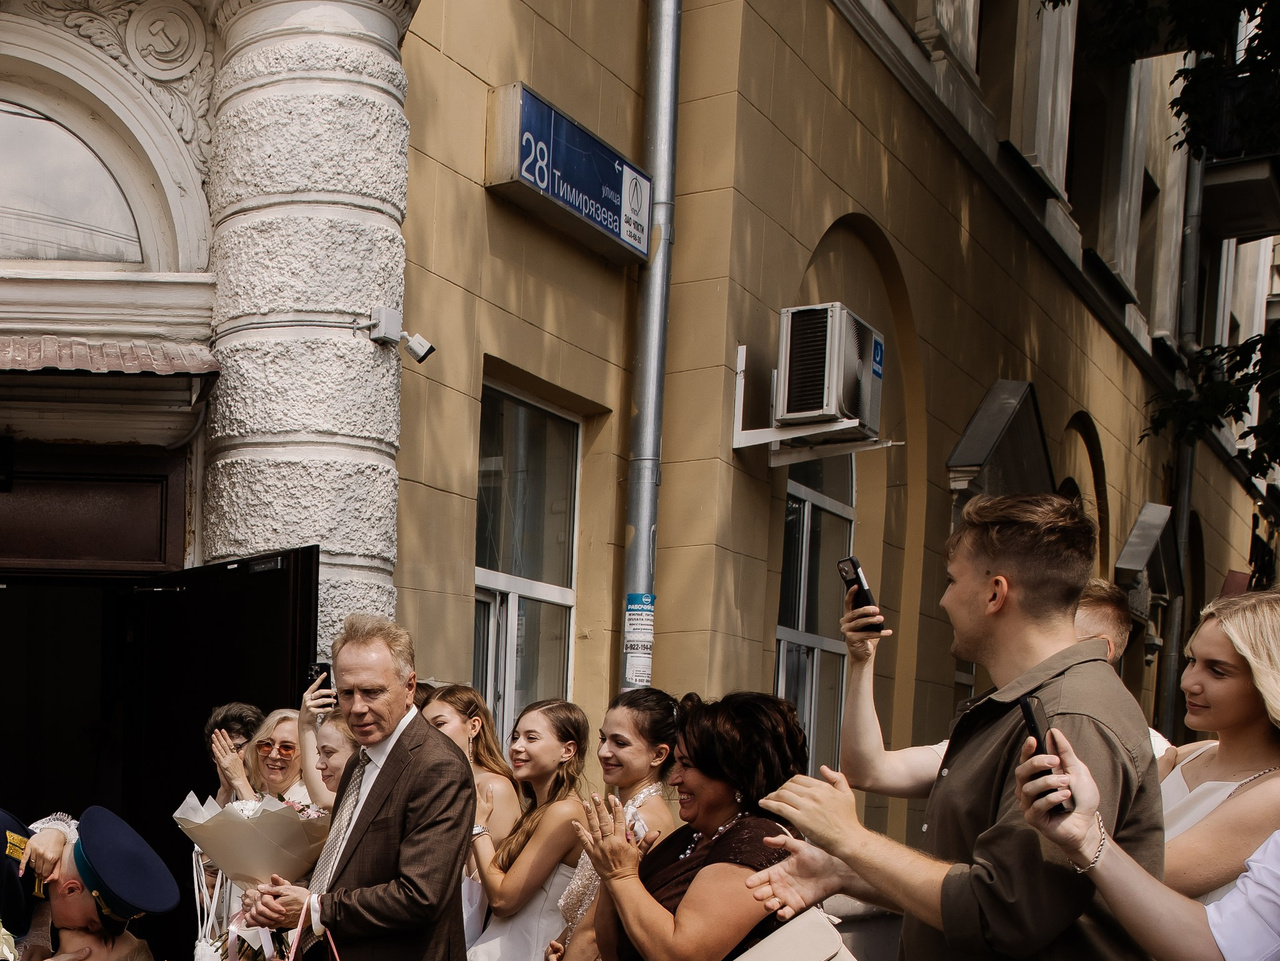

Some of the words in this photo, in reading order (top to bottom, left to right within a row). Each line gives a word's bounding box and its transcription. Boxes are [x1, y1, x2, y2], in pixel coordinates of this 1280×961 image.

[521, 131, 549, 189] 28
[552, 168, 620, 234] Тимирязева
[601, 184, 621, 206] улица
